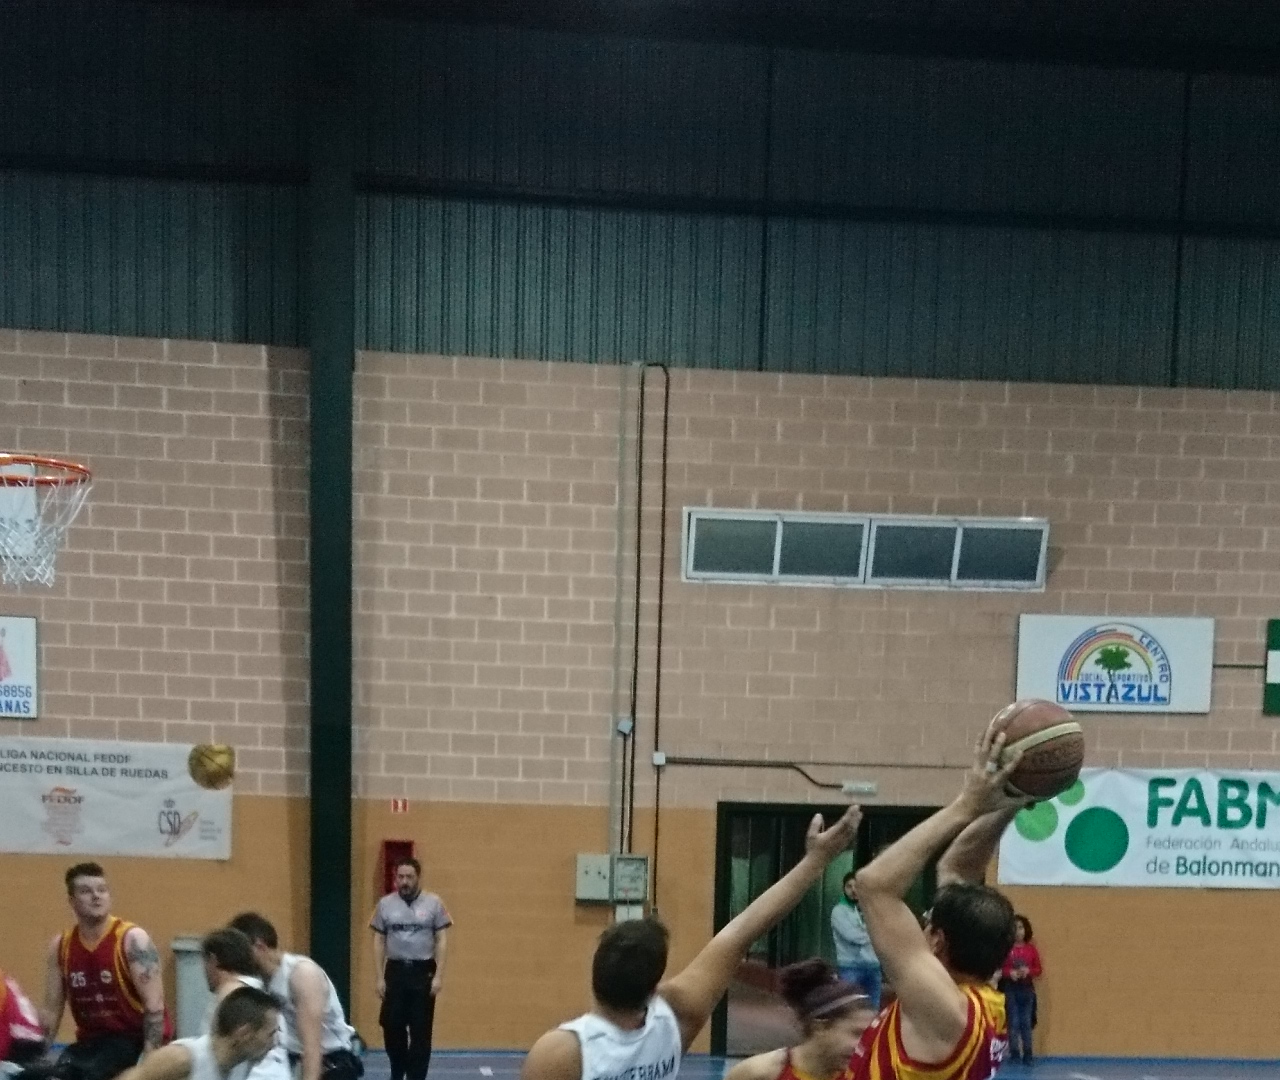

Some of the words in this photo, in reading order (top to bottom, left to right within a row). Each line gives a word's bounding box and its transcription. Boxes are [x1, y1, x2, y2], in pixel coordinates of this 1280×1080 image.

[1139, 634, 1170, 683] CENTRO
[1059, 682, 1168, 703] VISTAZUL
[0, 749, 27, 760] LIGA
[30, 750, 91, 763] NACIONAL
[46, 765, 63, 775] EN
[65, 766, 99, 777] SILLA
[101, 767, 117, 778] DE
[120, 768, 169, 779] RUEDAS
[1145, 835, 1222, 851] Federación
[1145, 855, 1170, 875] de
